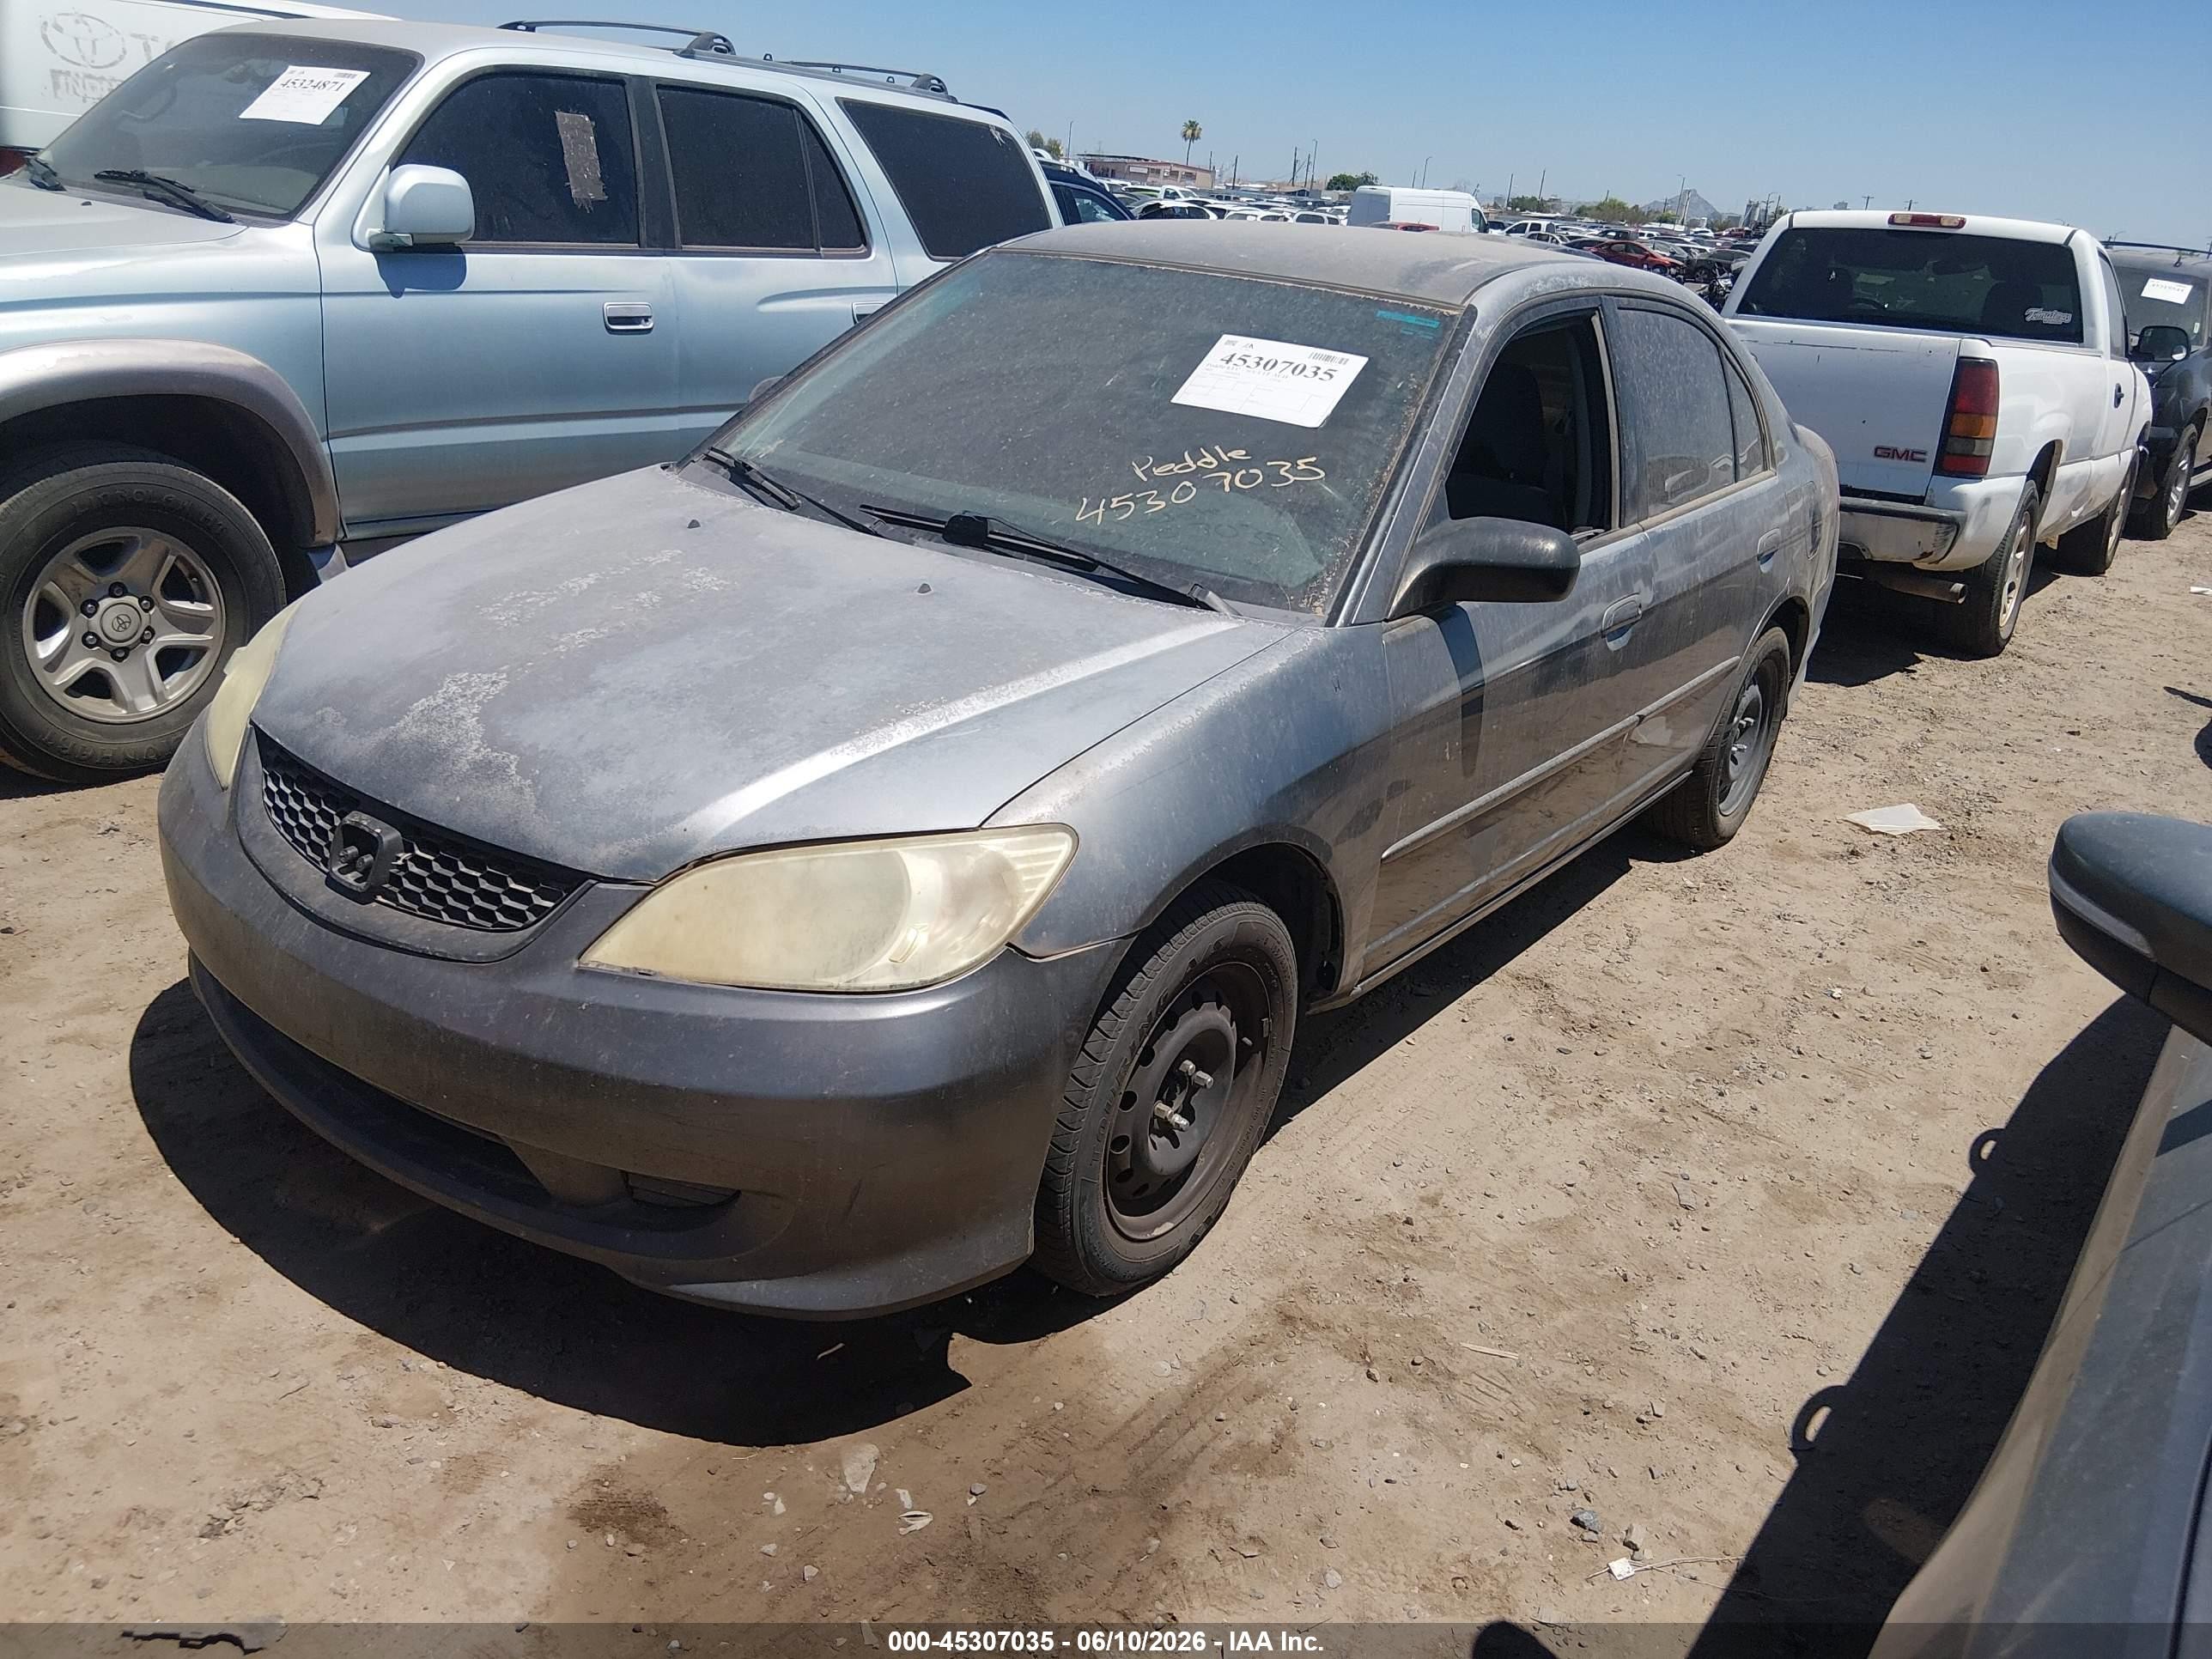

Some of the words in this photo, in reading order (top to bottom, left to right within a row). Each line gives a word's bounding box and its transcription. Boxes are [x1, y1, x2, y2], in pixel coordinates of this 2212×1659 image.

[281, 77, 346, 92] 45324871
[1219, 352, 1339, 382] 45307035
[1132, 446, 1251, 482] Peddle
[1874, 447, 1928, 463] GMC
